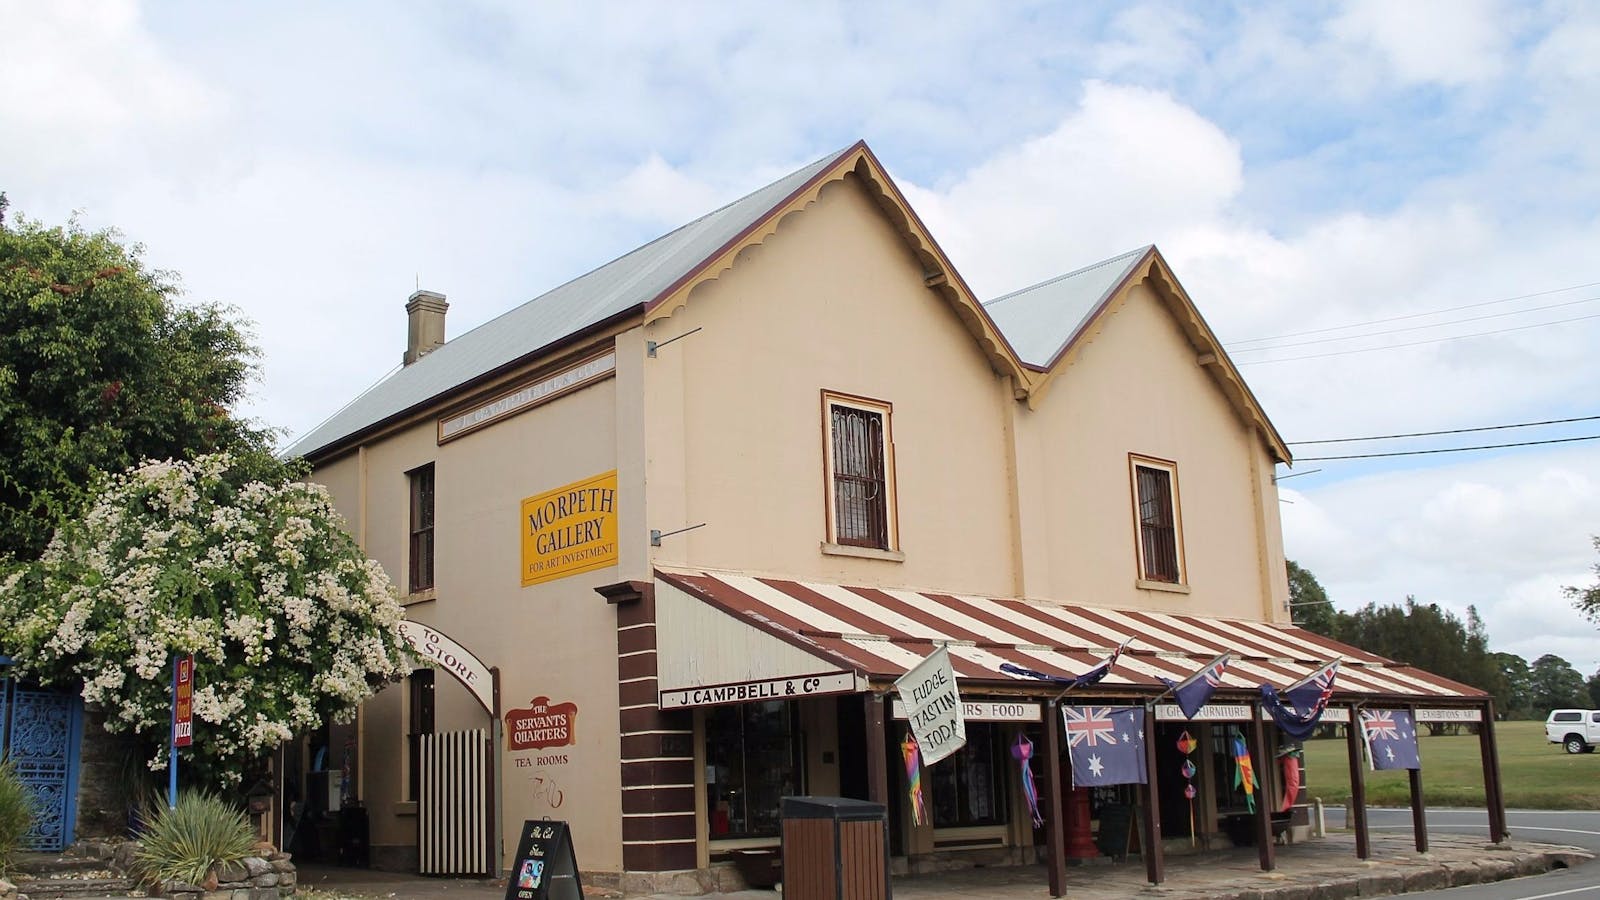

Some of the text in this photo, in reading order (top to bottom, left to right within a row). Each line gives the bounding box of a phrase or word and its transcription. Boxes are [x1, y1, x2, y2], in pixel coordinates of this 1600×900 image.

[529, 488, 614, 536] MORPETH
[536, 516, 604, 555] GALLERY
[529, 542, 614, 573] FOR ART INVESTMENT
[423, 629, 440, 643] TO
[424, 642, 478, 685] STORE
[693, 683, 779, 703] CAMPBELL
[785, 681, 795, 695] &
[912, 668, 948, 705] FUDGE
[533, 705, 547, 714] THE
[913, 690, 956, 730] TASTIN
[992, 705, 1024, 717] FOOD
[174, 719, 191, 743] pizza
[516, 713, 567, 731] SERVANTS
[924, 719, 957, 749] TODA
[514, 727, 568, 745] QUARTERS
[515, 755, 569, 768] TEA ROOMS
